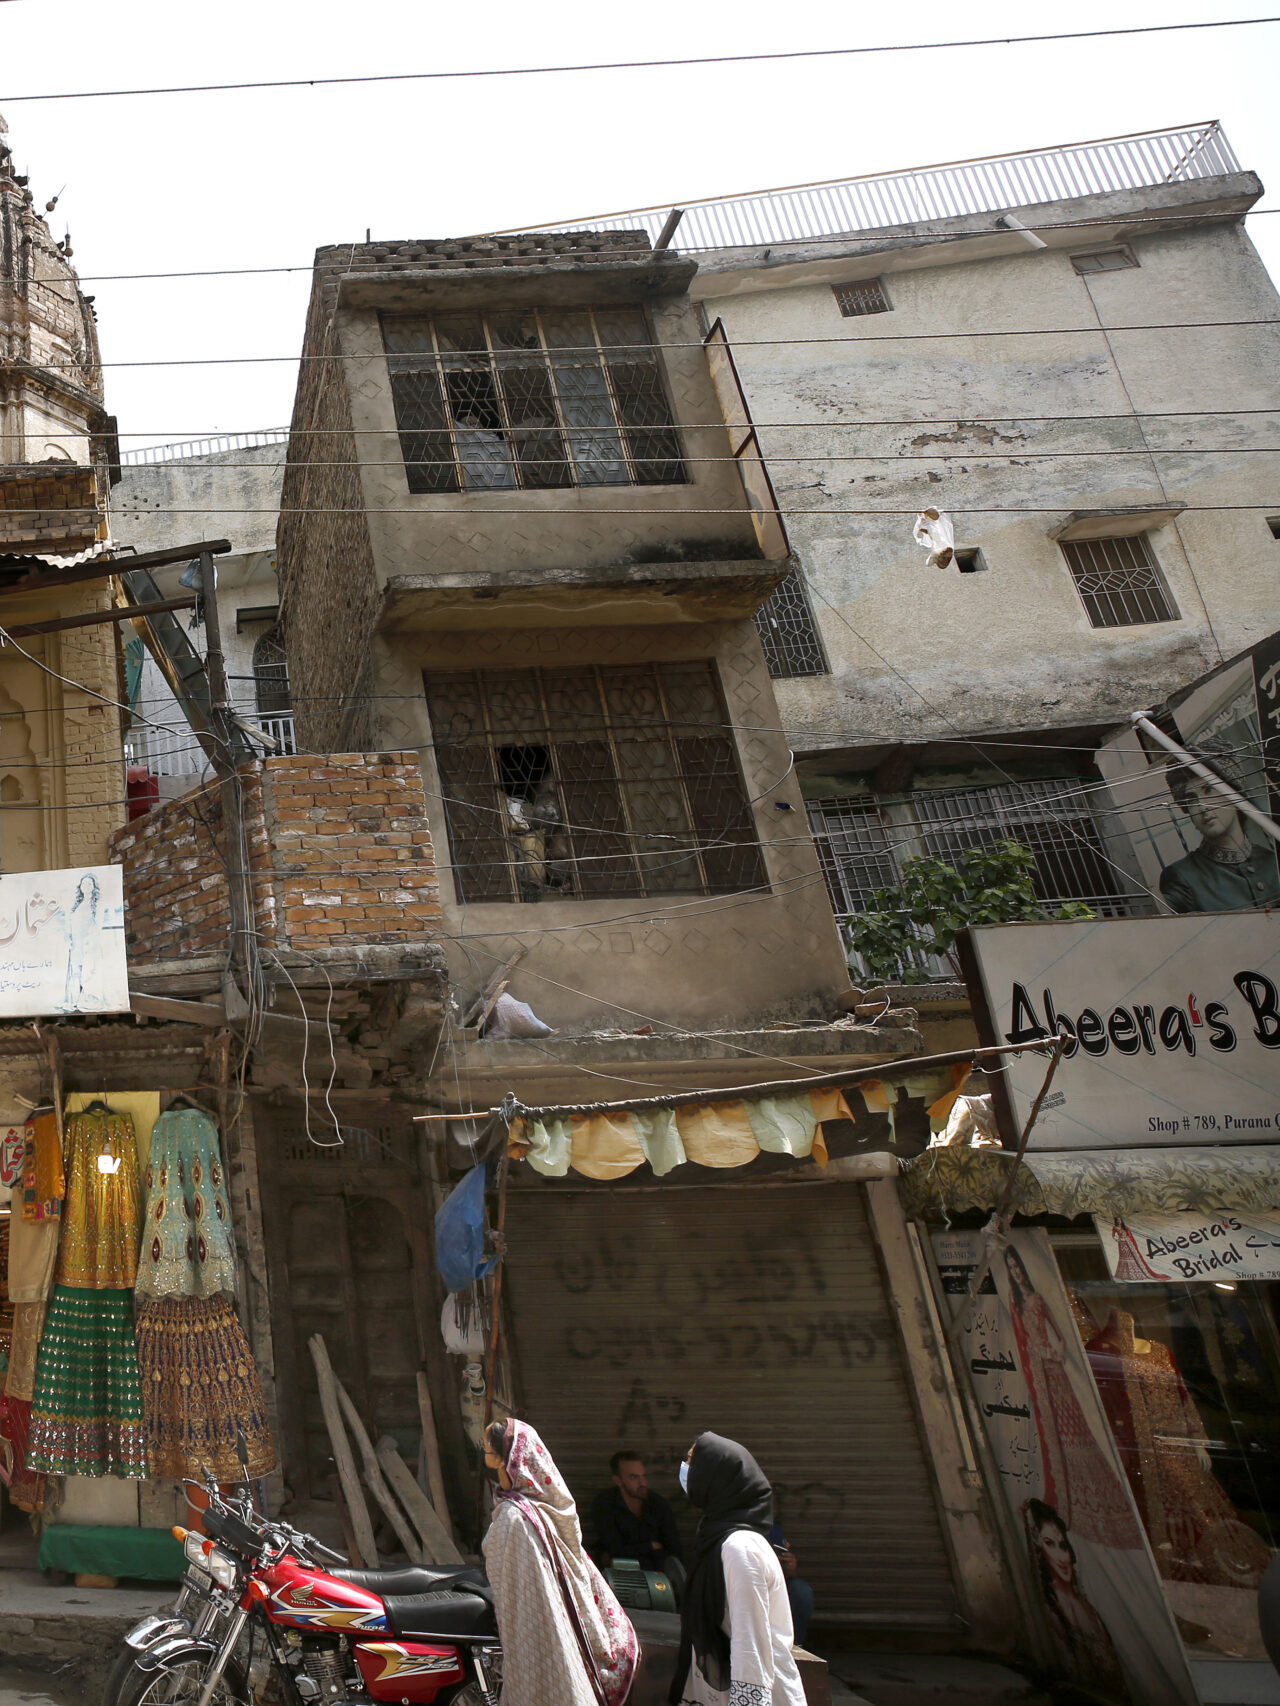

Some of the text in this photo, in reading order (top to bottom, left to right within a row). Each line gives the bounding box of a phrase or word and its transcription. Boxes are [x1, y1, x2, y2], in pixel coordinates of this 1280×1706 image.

[1005, 981, 1238, 1059] Abeera's
[1148, 1116, 1179, 1135] Shop
[1182, 1116, 1191, 1131] #
[1194, 1115, 1221, 1132] 789,
[1224, 1114, 1271, 1130] Purana
[1146, 1217, 1242, 1260] Abeera's
[1172, 1243, 1243, 1279] Bridal
[1235, 1271, 1257, 1279] Shop
